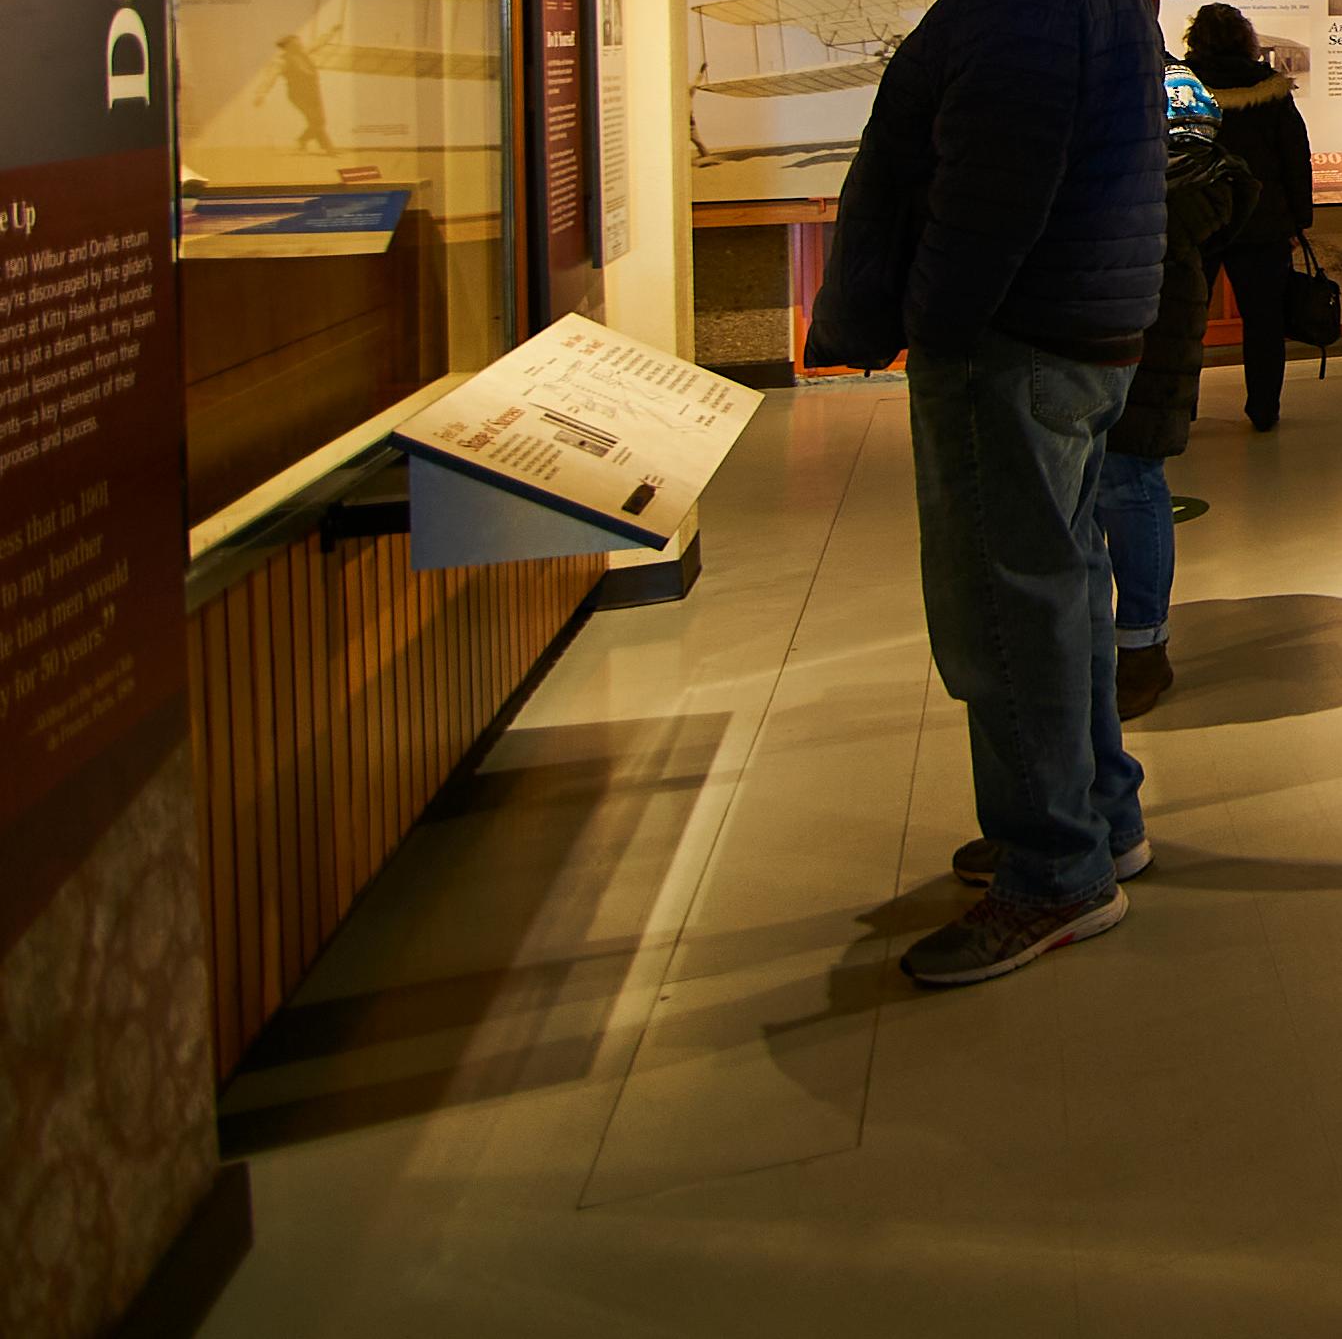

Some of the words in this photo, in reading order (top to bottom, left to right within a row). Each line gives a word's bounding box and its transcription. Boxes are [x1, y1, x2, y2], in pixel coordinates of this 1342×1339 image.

[12, 201, 36, 235] Up
[0, 291, 25, 314] ey’re
[15, 667, 37, 699] for
